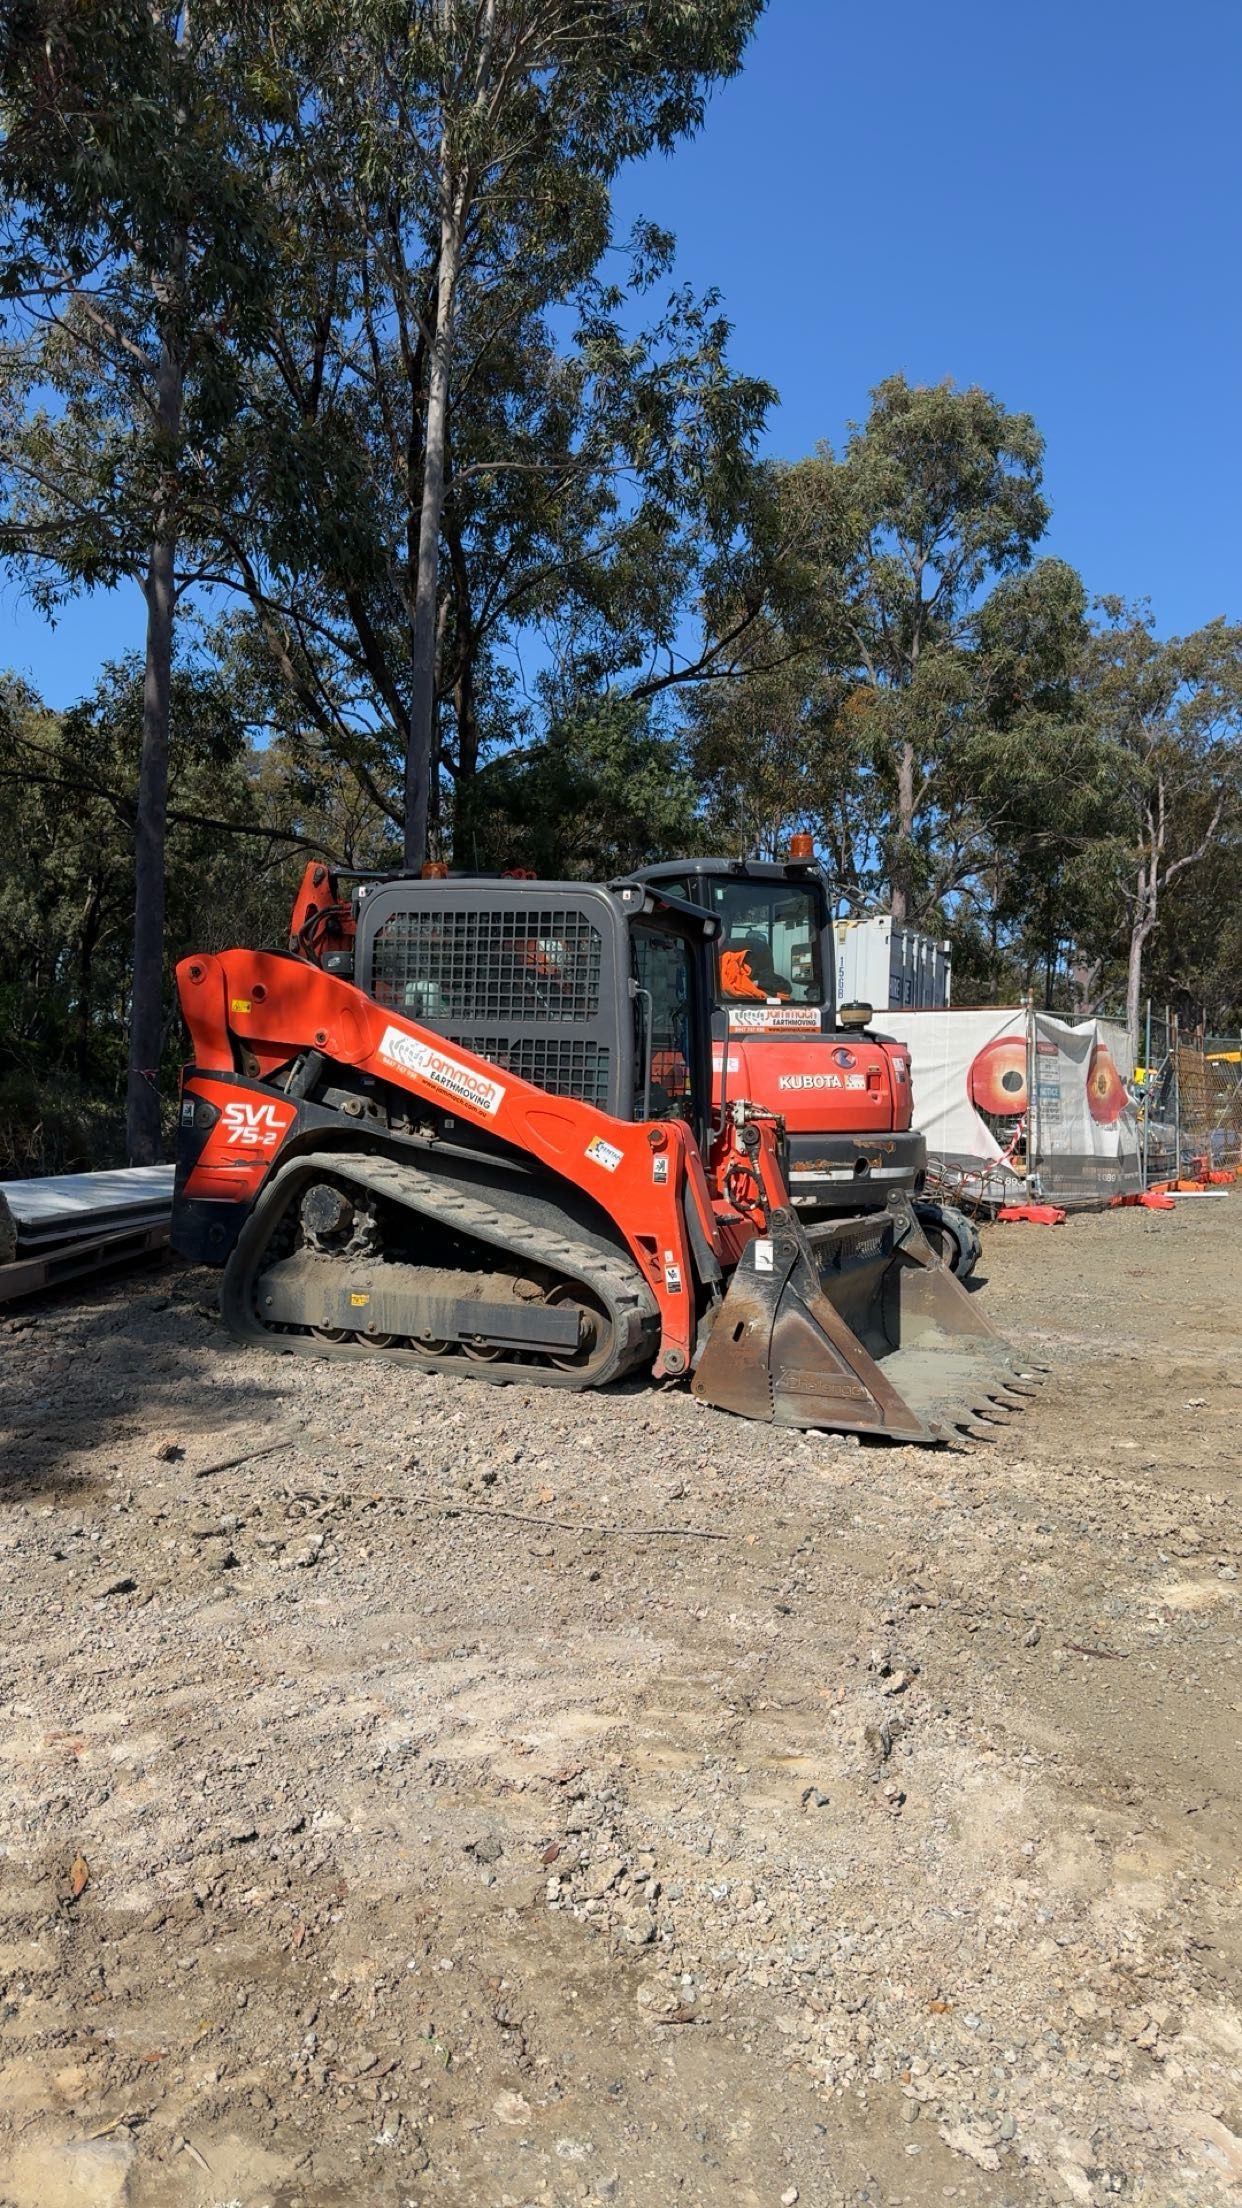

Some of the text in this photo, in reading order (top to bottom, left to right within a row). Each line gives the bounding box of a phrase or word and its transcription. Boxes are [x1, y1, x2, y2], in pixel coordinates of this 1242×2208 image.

[766, 1008, 817, 1020] jammach
[423, 1052, 496, 1100] jammach
[779, 1074, 843, 1089] KUBOTA
[422, 1079, 487, 1118] www.jammach.com.au
[430, 1071, 491, 1109] EARTHMOVING
[221, 1103, 287, 1128] SVL
[227, 1126, 277, 1145] 75-2
